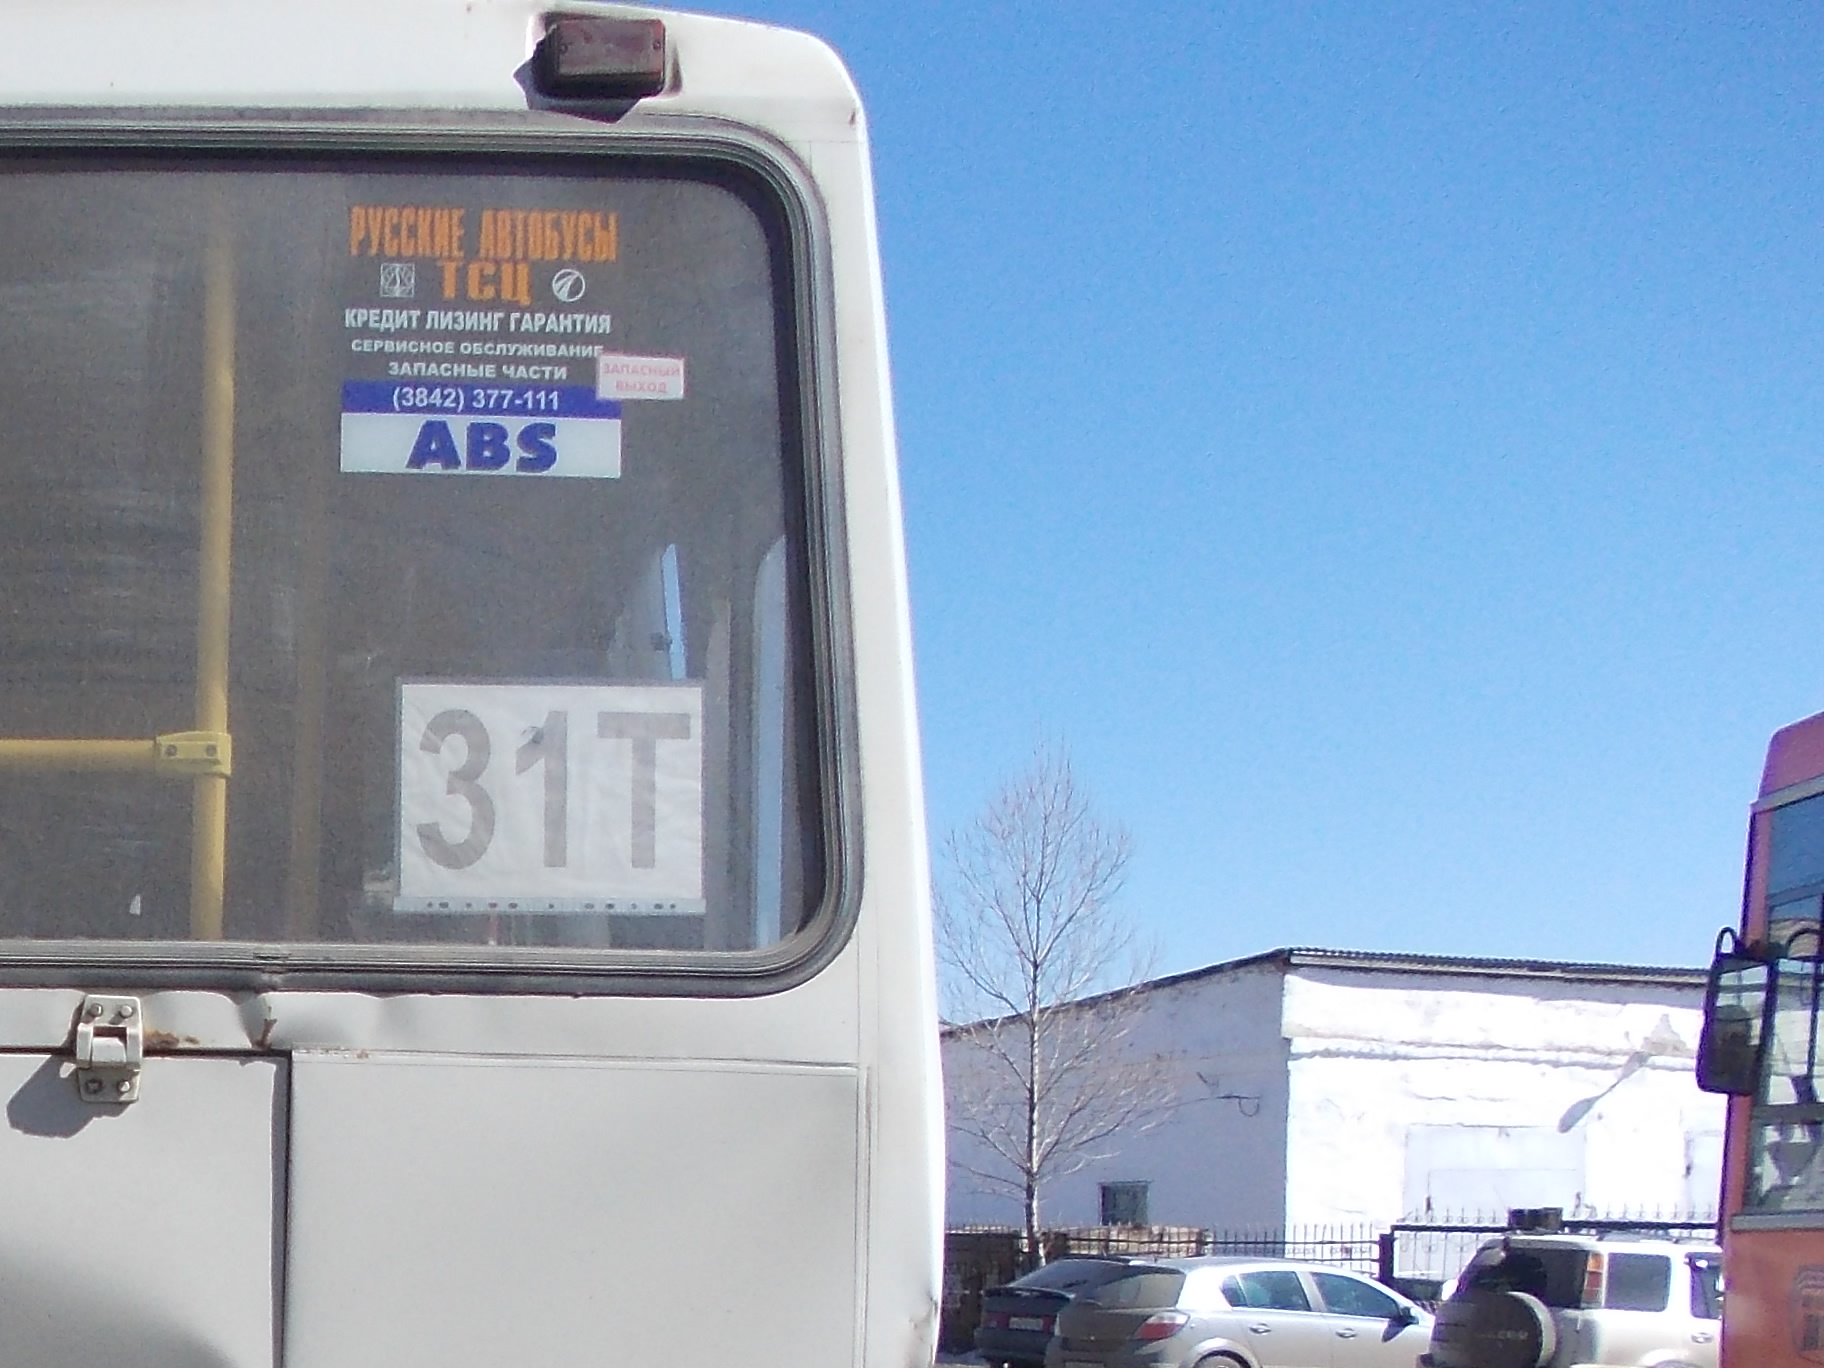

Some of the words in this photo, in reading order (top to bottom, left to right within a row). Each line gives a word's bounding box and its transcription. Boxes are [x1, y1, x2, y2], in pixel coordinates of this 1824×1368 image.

[349, 205, 465, 258] РУССКИЕ
[478, 208, 619, 263] АВТОБУСЫ
[436, 259, 533, 307] ТСЦ
[344, 308, 421, 333] КРЕДИТ
[425, 310, 504, 332] ЛИЗИНГ
[509, 312, 612, 334] ГАРАНТИЯ
[351, 339, 455, 354] СЕРВИСНОЕ
[460, 341, 604, 358] ОБСЛУЖИВАНИЕ
[388, 361, 497, 378] ЗАПАСНЫЕ
[502, 364, 568, 380] ЧАСТИ
[393, 386, 465, 413] (3842)
[472, 388, 560, 411] 377-111
[615, 379, 668, 394] ВЫХОД
[405, 419, 558, 474] ABS
[416, 708, 692, 870] 31Т
